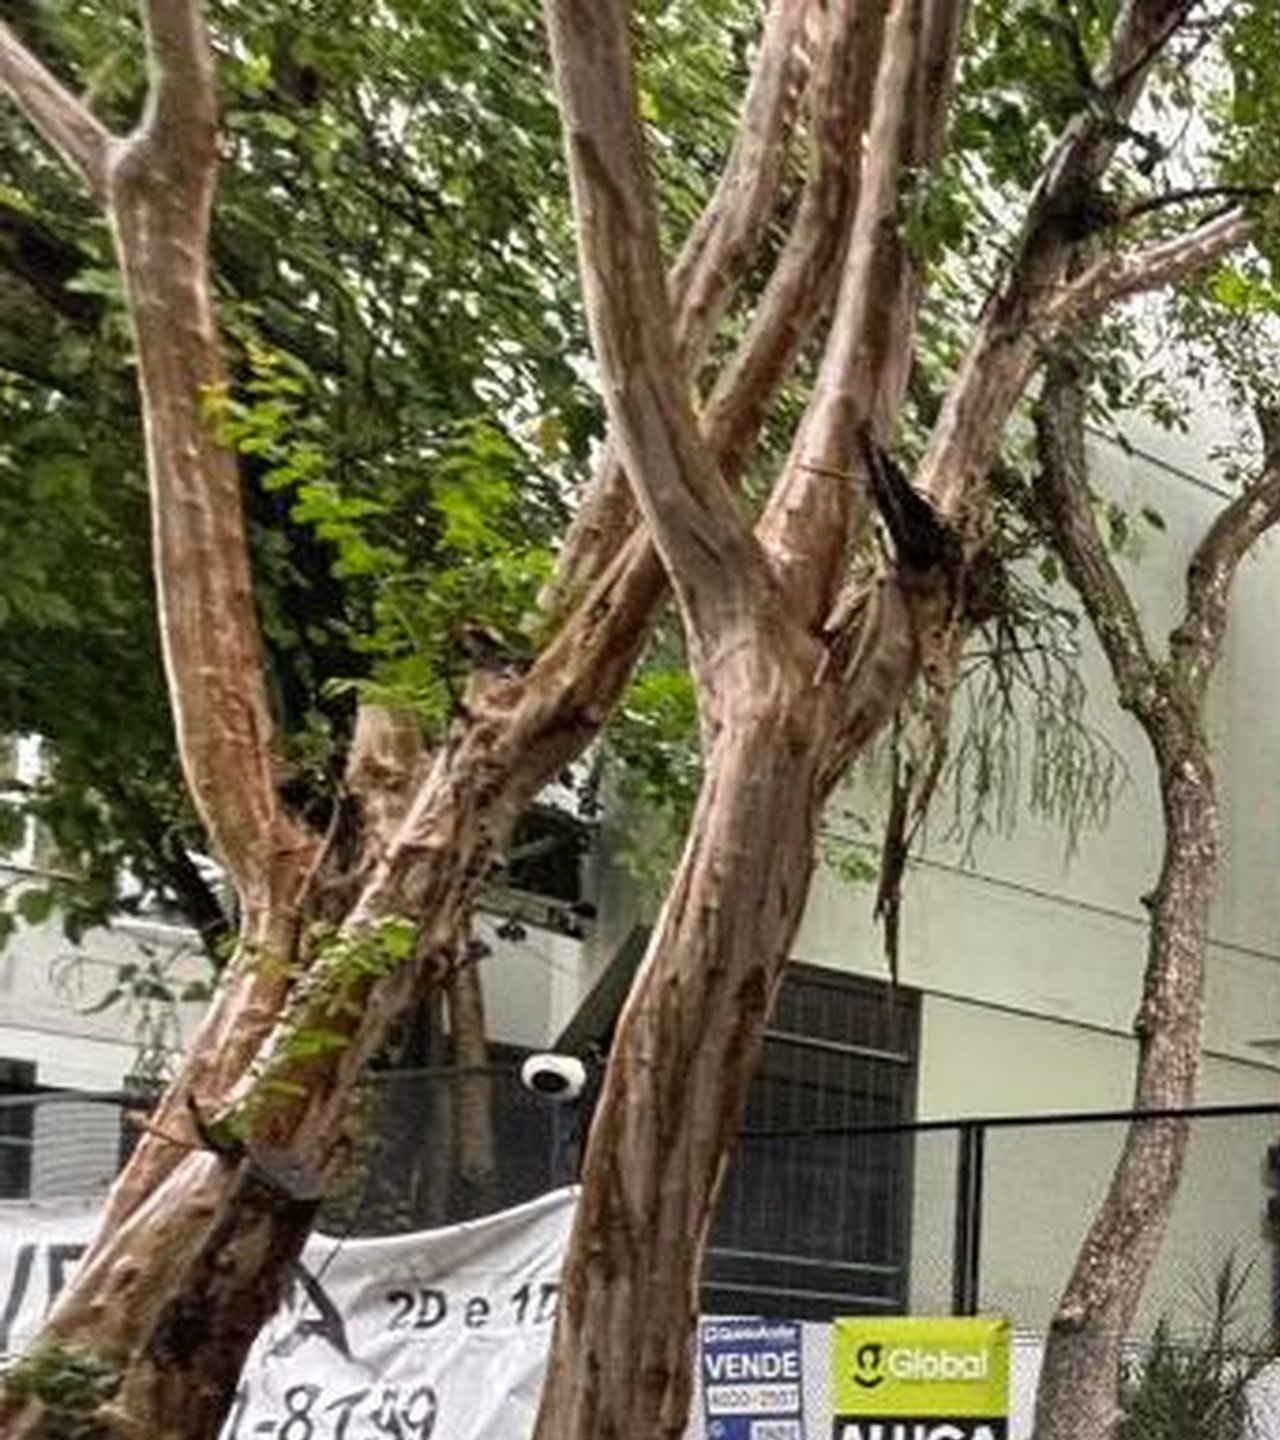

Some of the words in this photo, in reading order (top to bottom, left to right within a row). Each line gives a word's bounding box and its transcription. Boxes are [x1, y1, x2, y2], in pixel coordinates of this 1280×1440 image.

[464, 1296, 491, 1328] e
[704, 1351, 800, 1380] VENDE
[888, 1348, 989, 1381] Global
